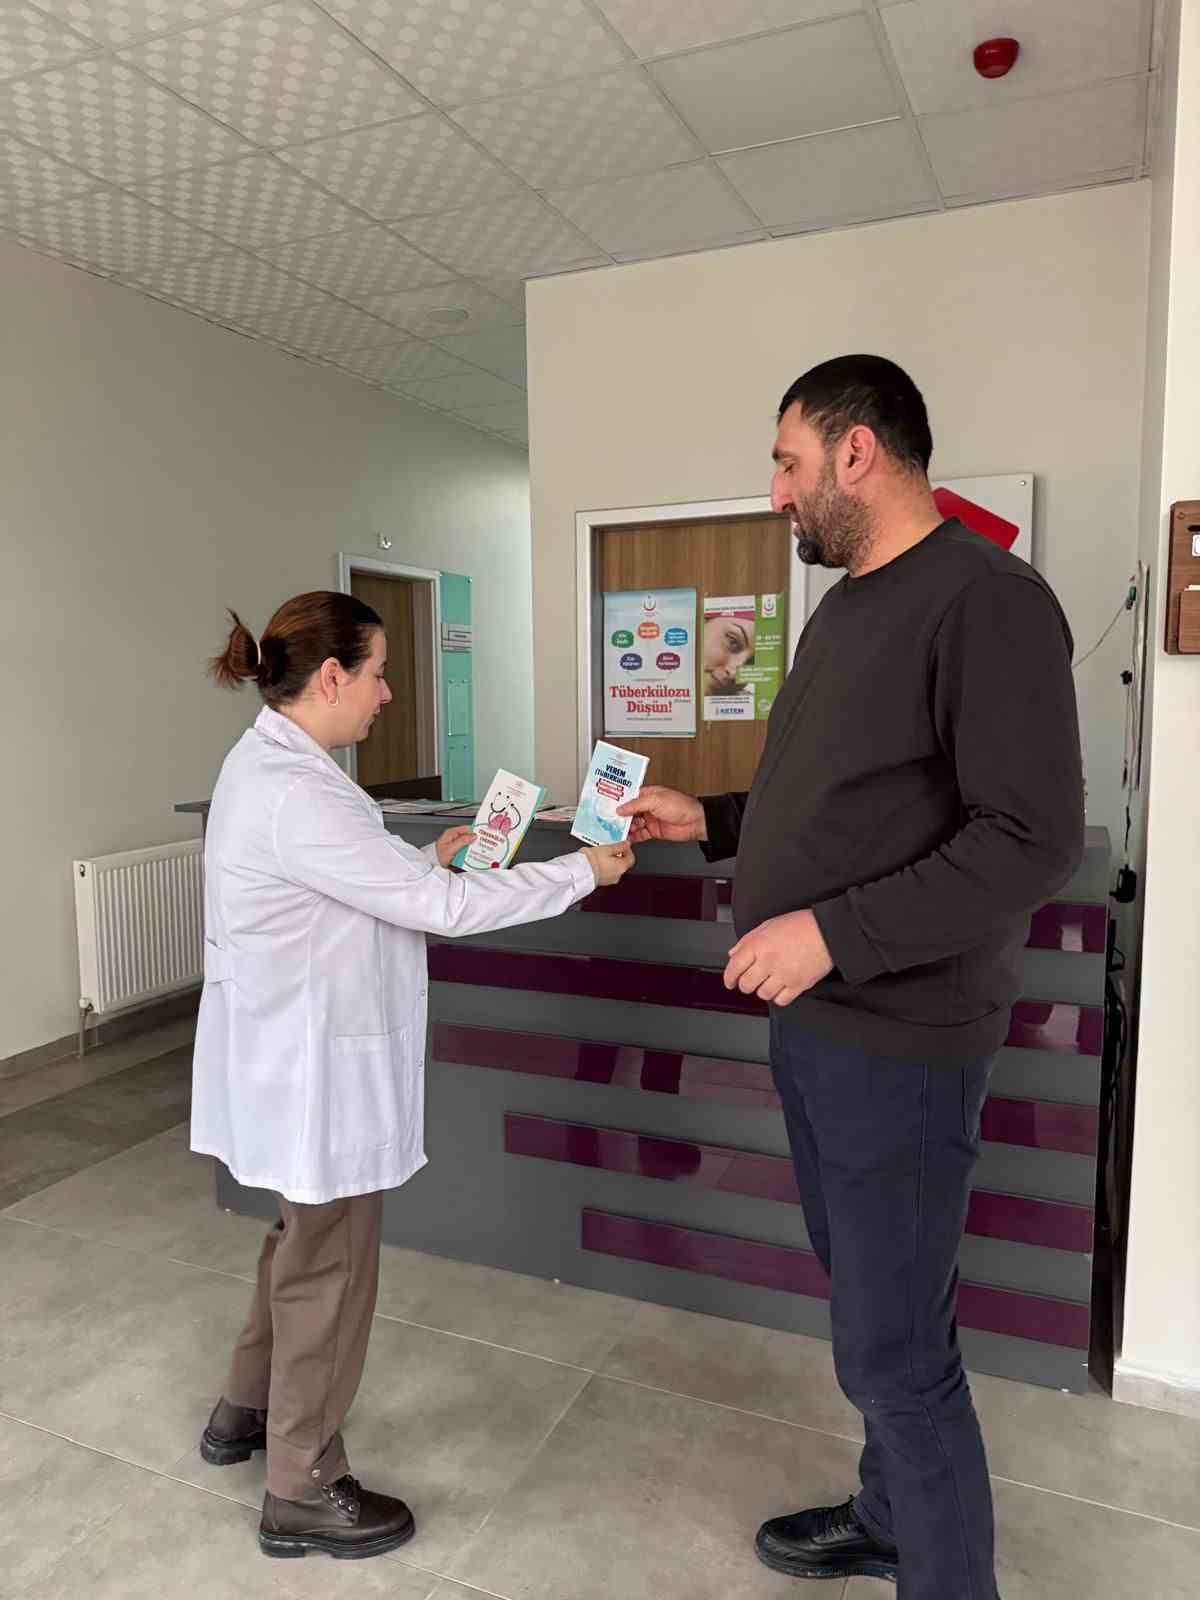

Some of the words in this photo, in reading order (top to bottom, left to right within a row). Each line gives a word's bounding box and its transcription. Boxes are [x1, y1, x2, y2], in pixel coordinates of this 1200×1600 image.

[609, 685, 690, 698] Tüberkülozu
[627, 701, 673, 716] Düşün!
[606, 764, 626, 777] VEREM
